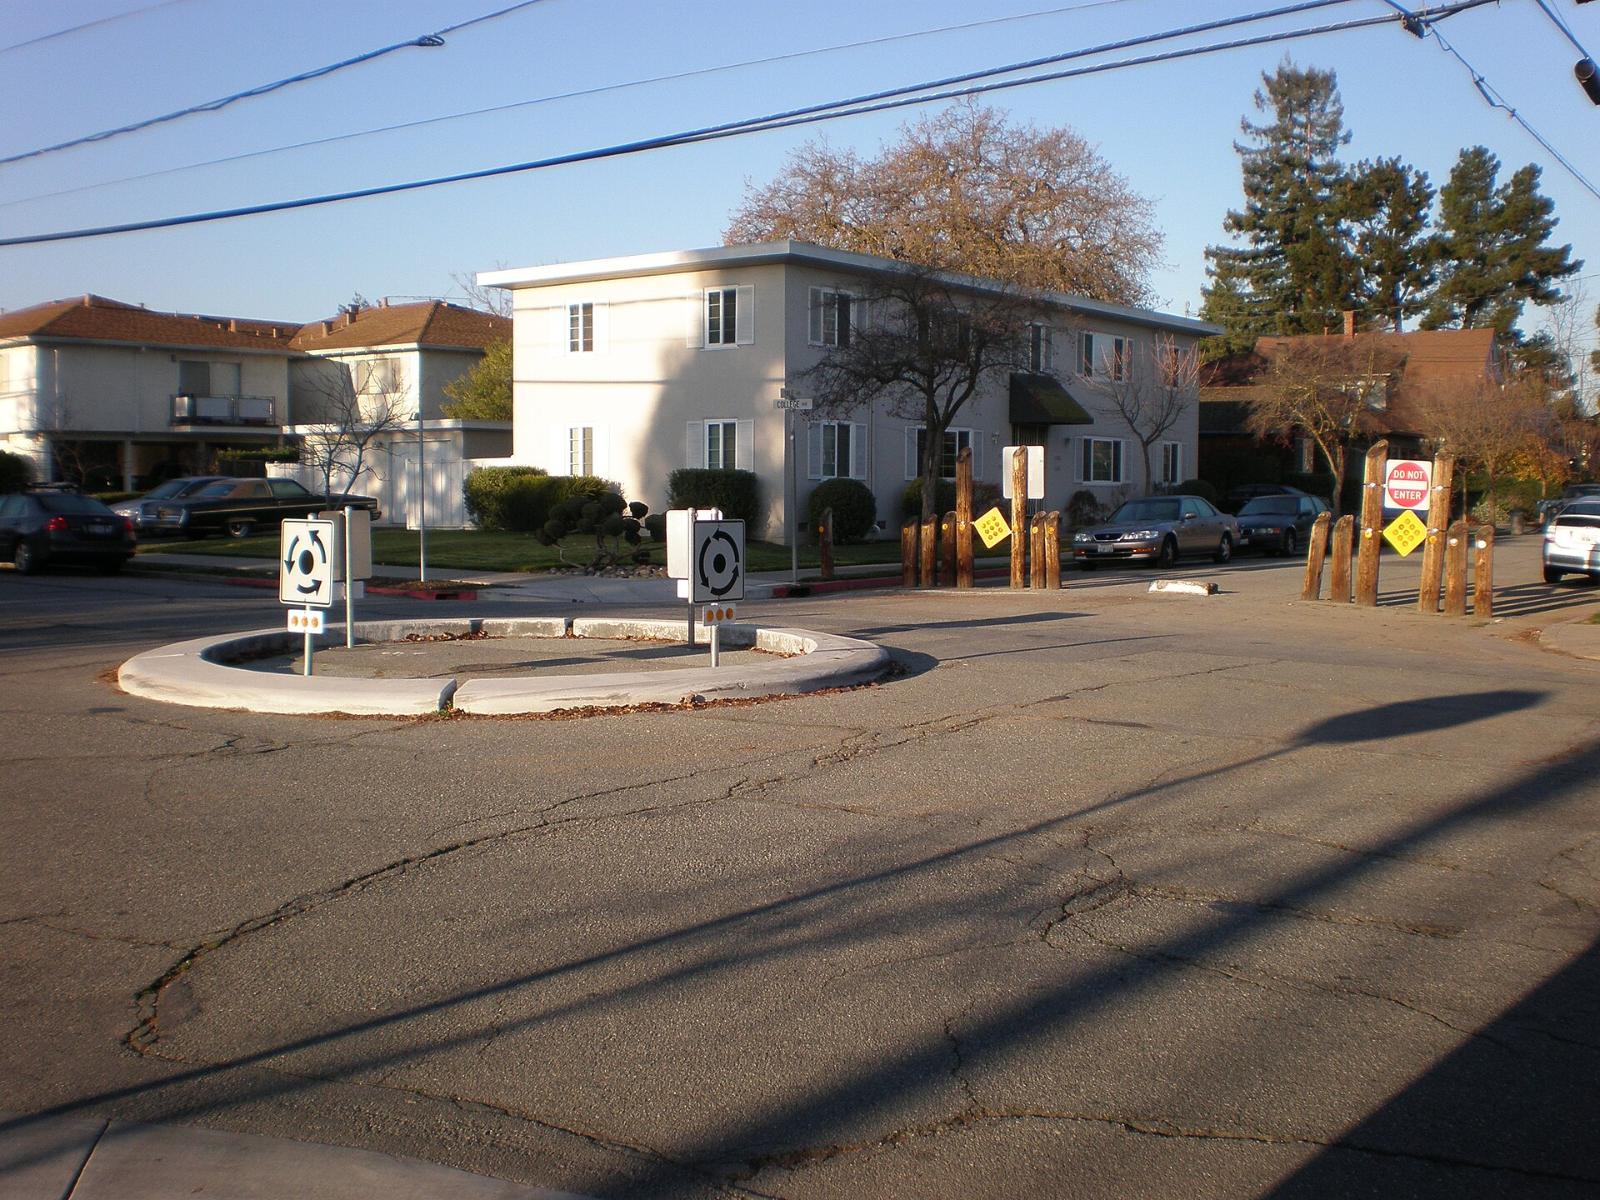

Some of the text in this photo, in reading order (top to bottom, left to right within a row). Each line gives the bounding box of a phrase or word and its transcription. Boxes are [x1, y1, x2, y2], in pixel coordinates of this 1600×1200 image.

[777, 400, 800, 409] COLLEGE
[1393, 470, 1424, 479] DO NOT
[1394, 491, 1421, 500] ENTER
